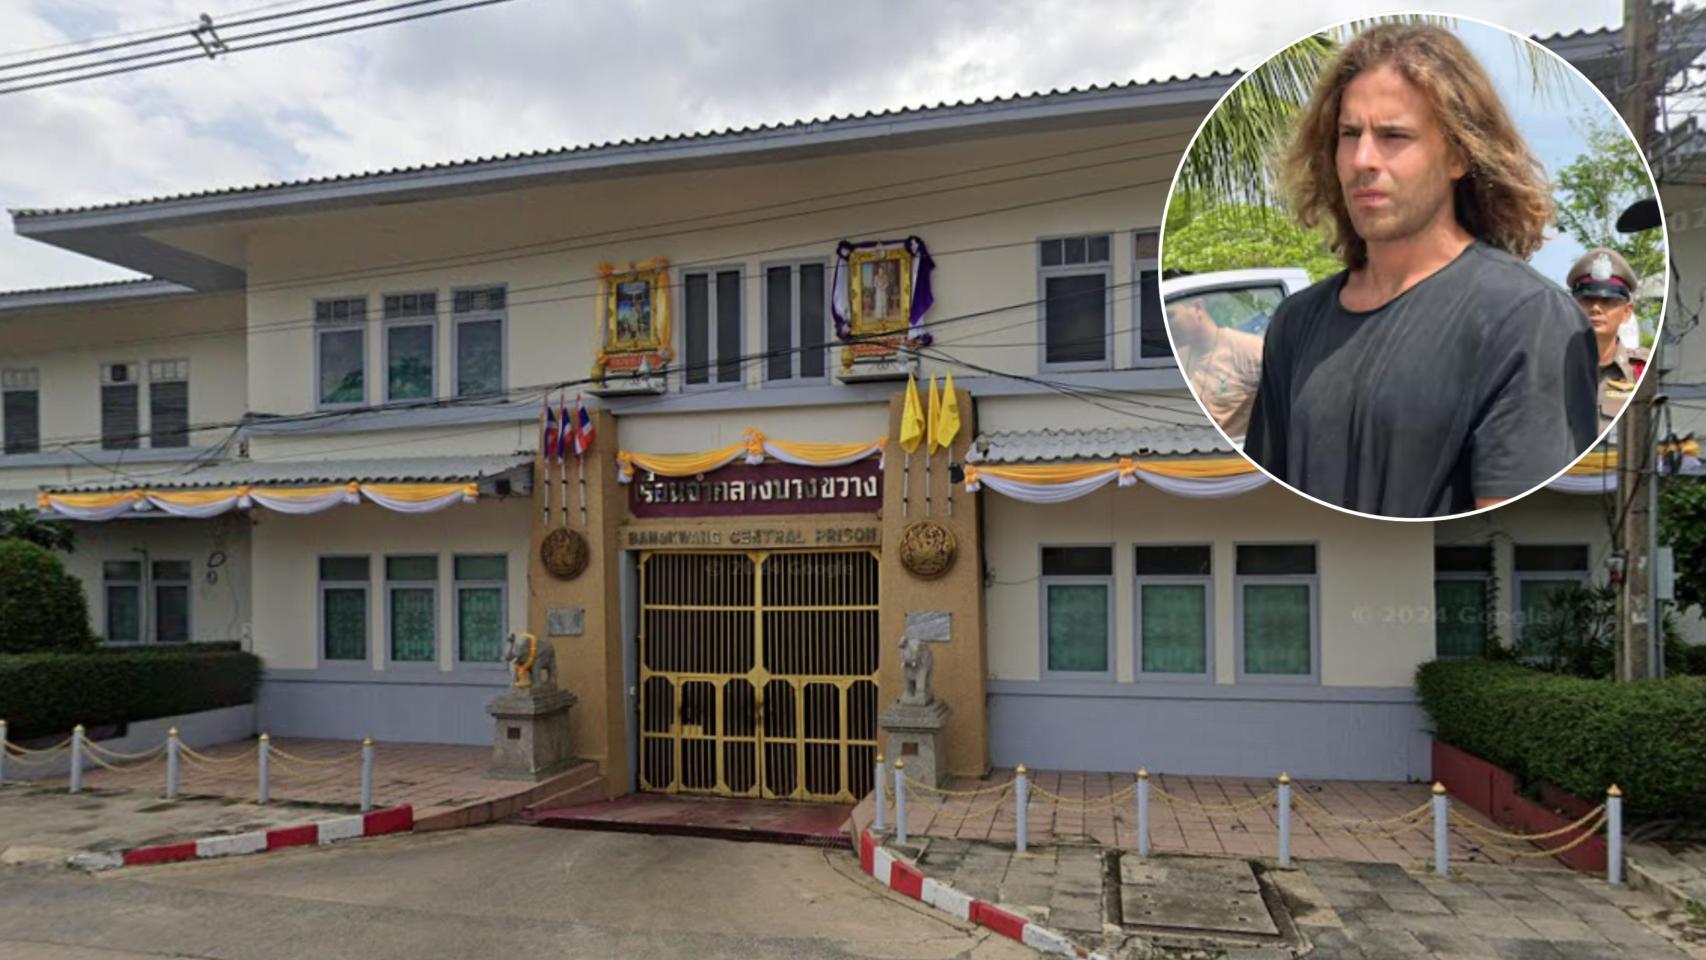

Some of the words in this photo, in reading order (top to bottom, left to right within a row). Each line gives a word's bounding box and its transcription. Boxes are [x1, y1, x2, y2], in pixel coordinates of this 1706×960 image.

[629, 530, 721, 545] BANGKWANG
[730, 529, 804, 544] CENTRAL
[815, 527, 876, 543] PRISON
